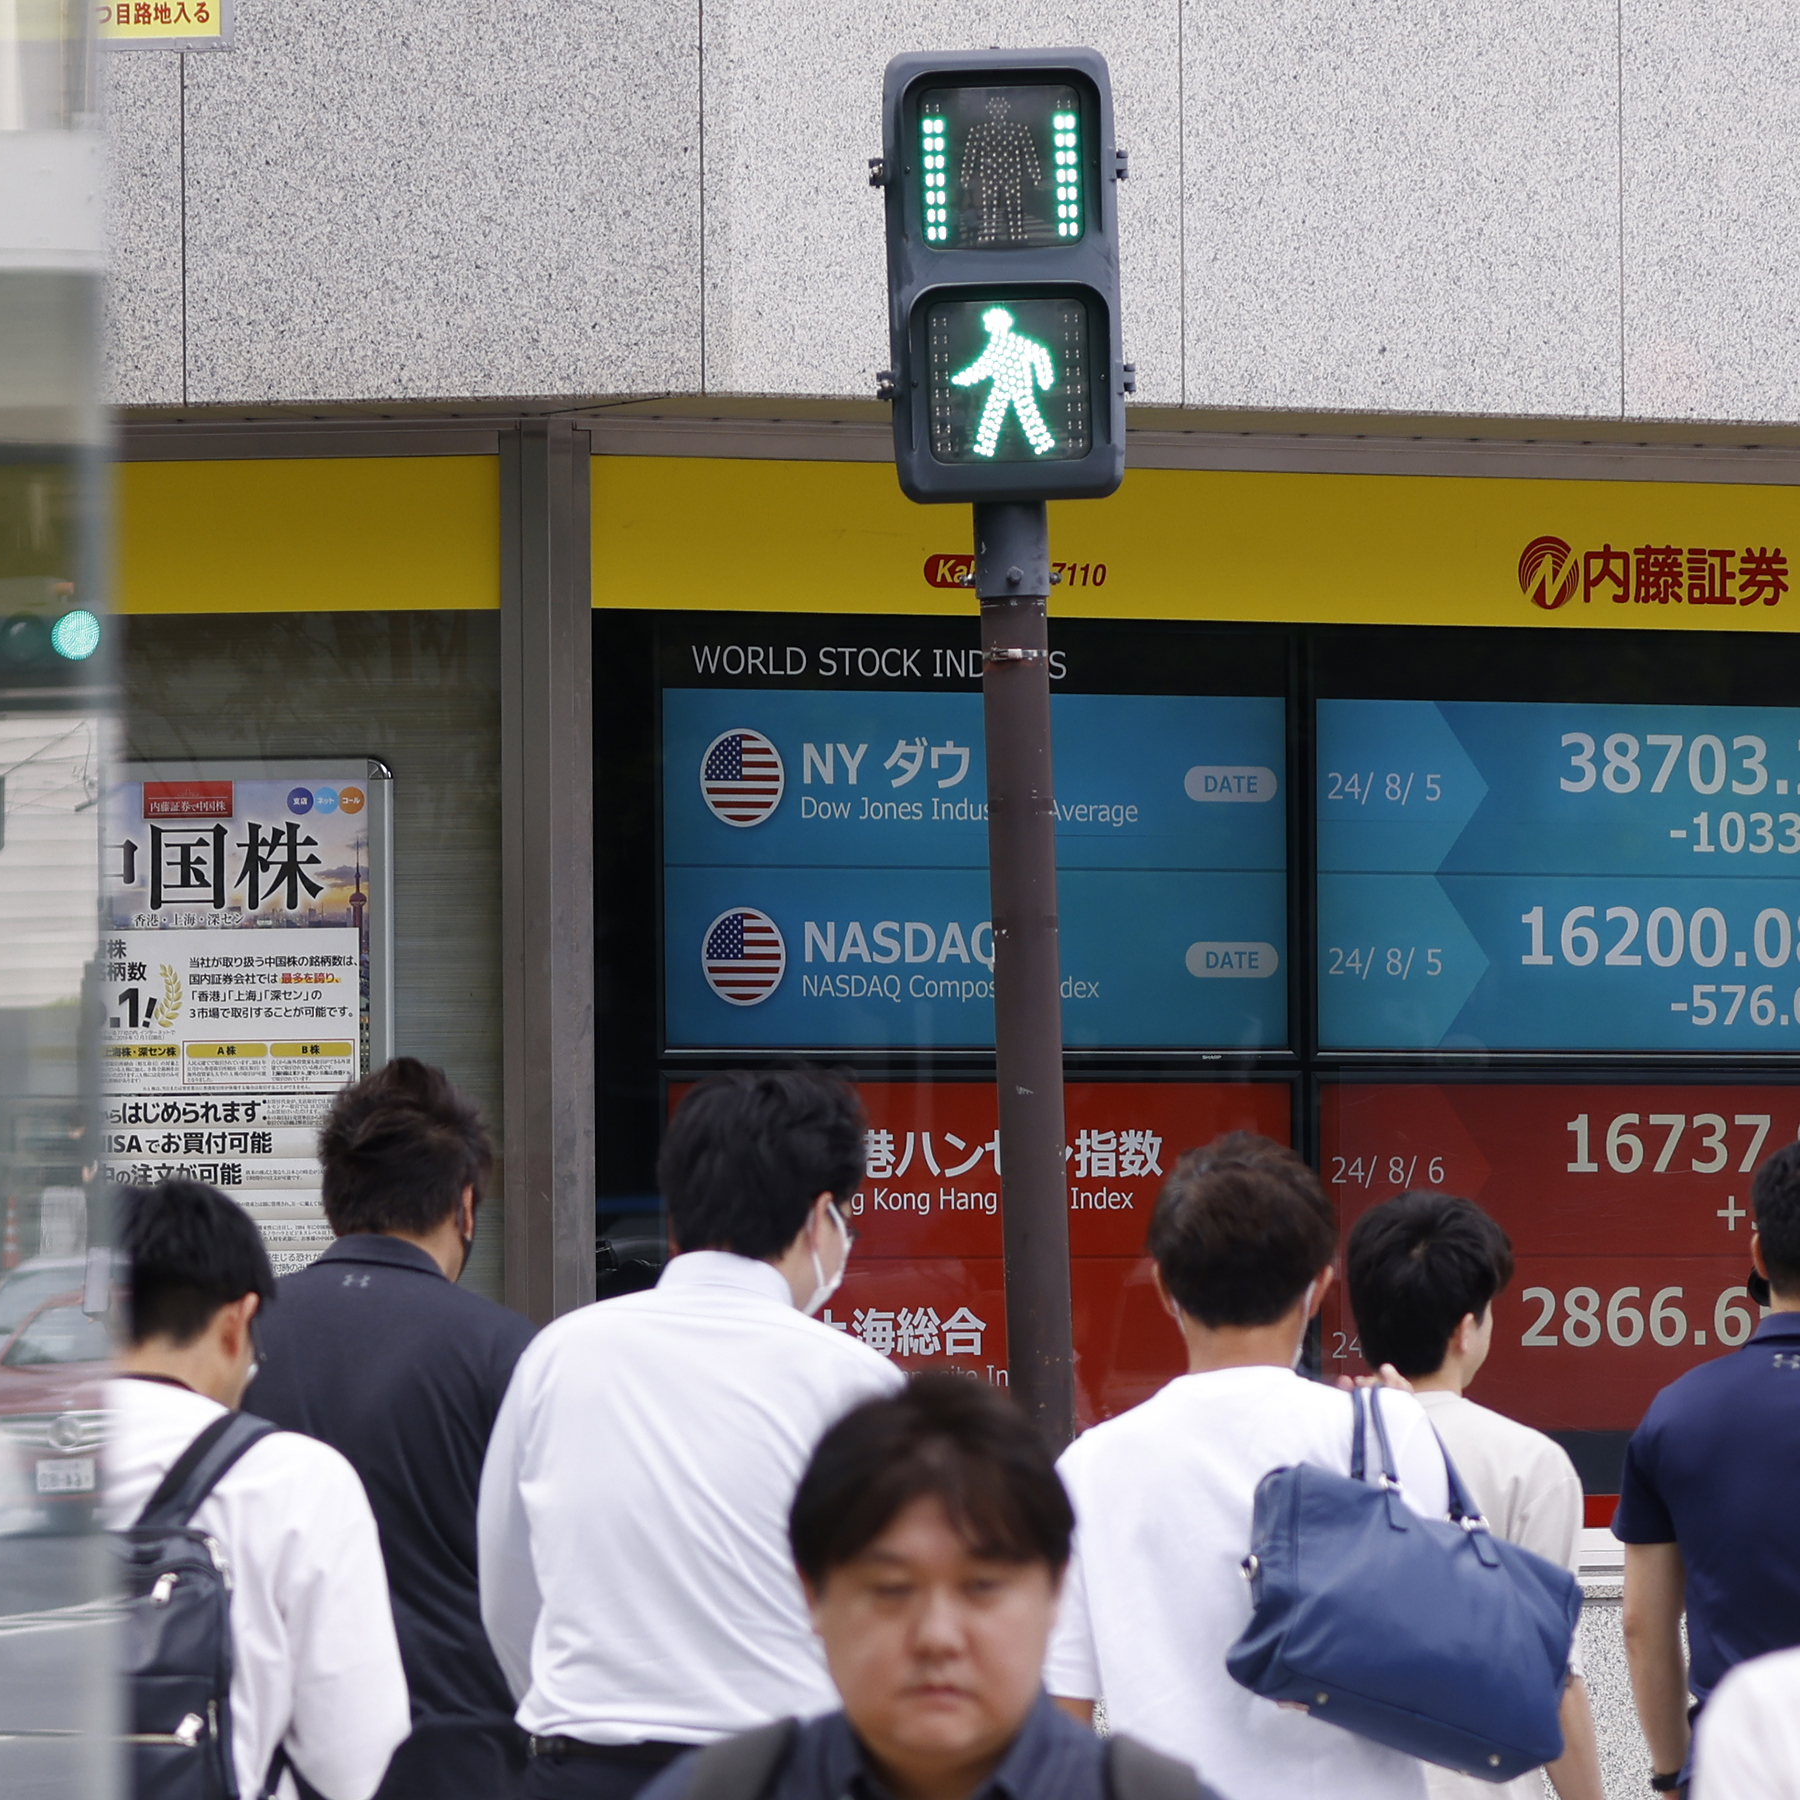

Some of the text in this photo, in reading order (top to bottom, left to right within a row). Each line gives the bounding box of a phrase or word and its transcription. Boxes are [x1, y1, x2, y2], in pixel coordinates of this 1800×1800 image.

[1583, 543, 1789, 606] 内藤証券
[692, 646, 807, 675] WORLD
[818, 647, 921, 677] STOCK
[802, 738, 970, 788] NY ダウ
[1204, 775, 1257, 793] DATE
[1327, 772, 1442, 805] 24/ 8/ 5
[150, 799, 227, 813] 内藤証券で中国株
[800, 797, 851, 819] Dow
[859, 797, 923, 820] Jones
[1205, 951, 1259, 970] DATE
[1328, 947, 1443, 981] 24/ 8/ 5
[802, 975, 901, 1002] NASDAQ
[1331, 1156, 1445, 1189] 24/ 8/ 6
[874, 1187, 931, 1215] Kong
[939, 1187, 997, 1213] Hang
[1070, 1187, 1134, 1210] Index
